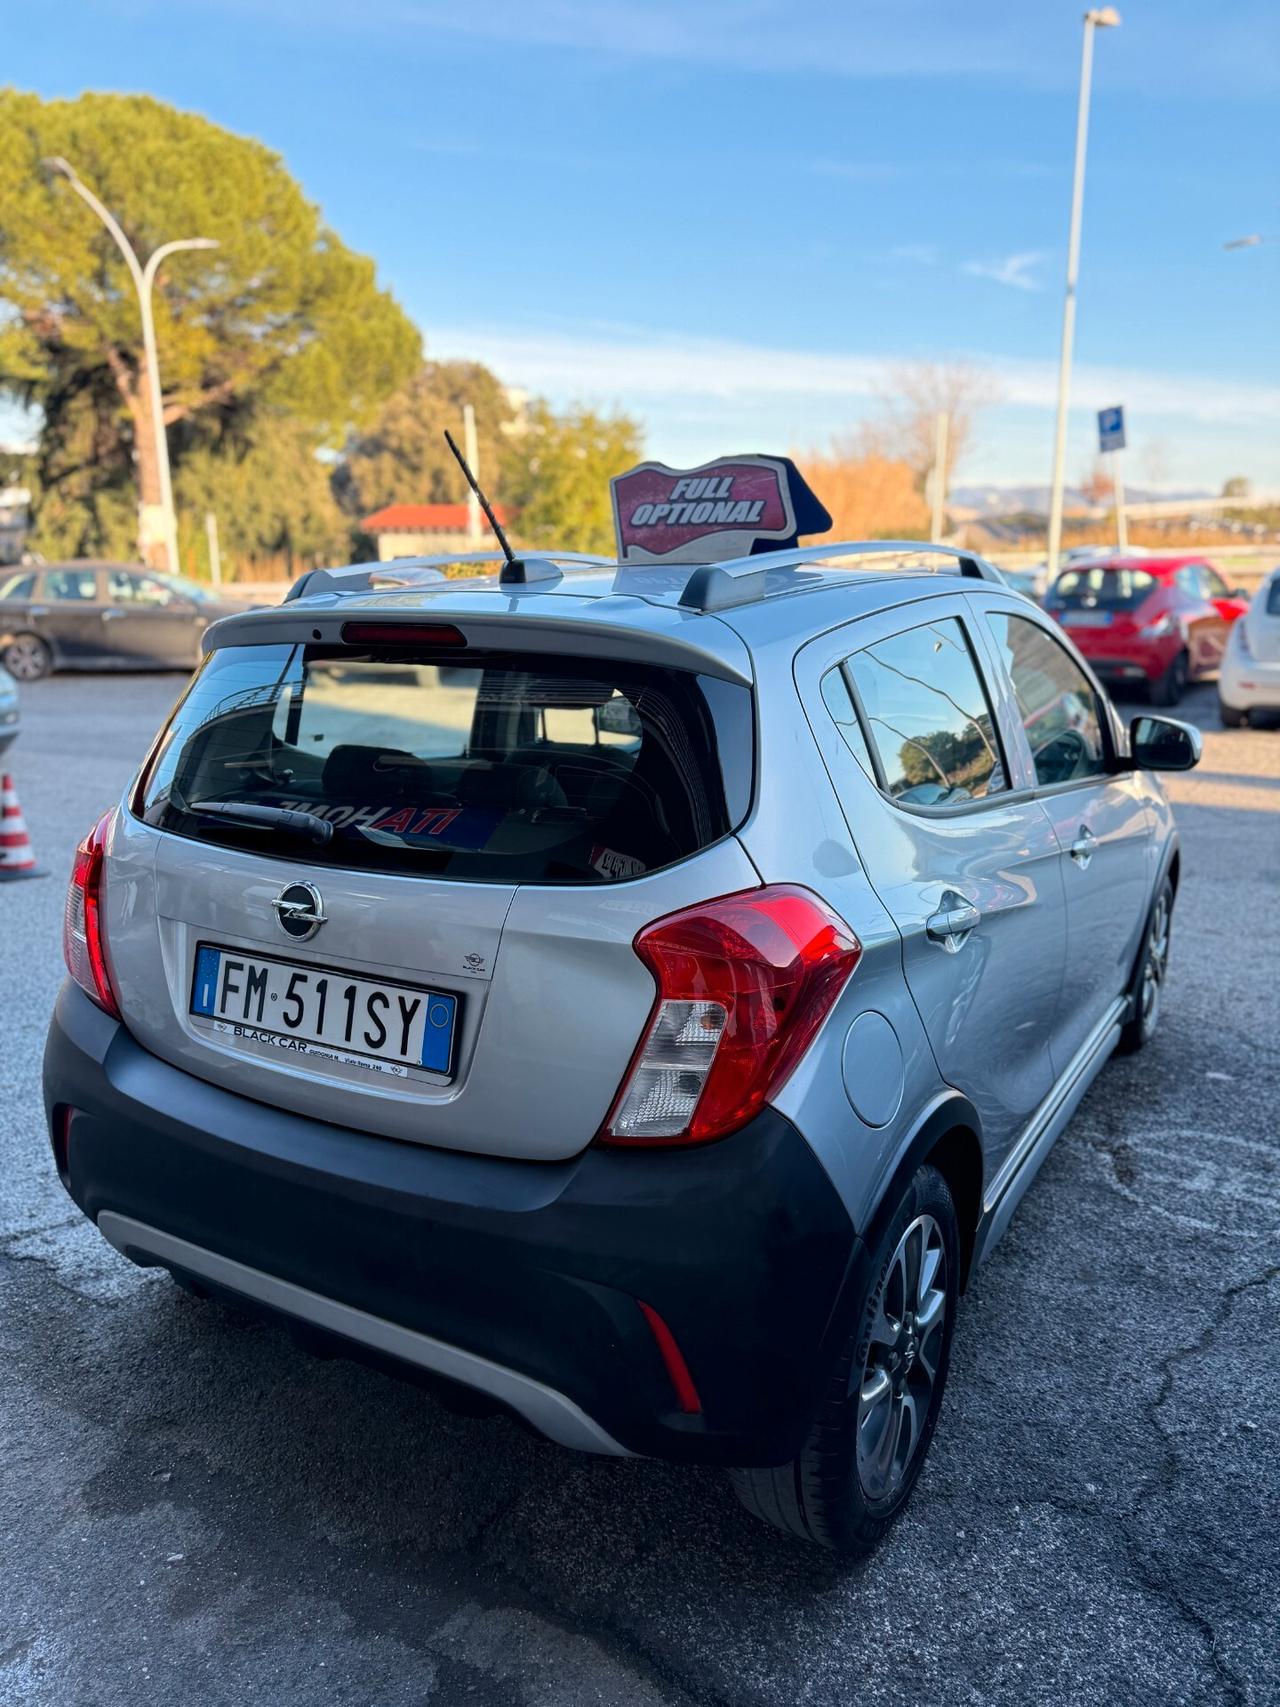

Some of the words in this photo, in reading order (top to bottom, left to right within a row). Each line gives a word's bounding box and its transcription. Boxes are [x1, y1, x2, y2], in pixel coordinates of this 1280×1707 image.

[669, 477, 734, 500] FULL
[630, 500, 766, 526] OPTIONAL
[233, 1026, 276, 1046] BLACK
[278, 1037, 308, 1053] CAR
